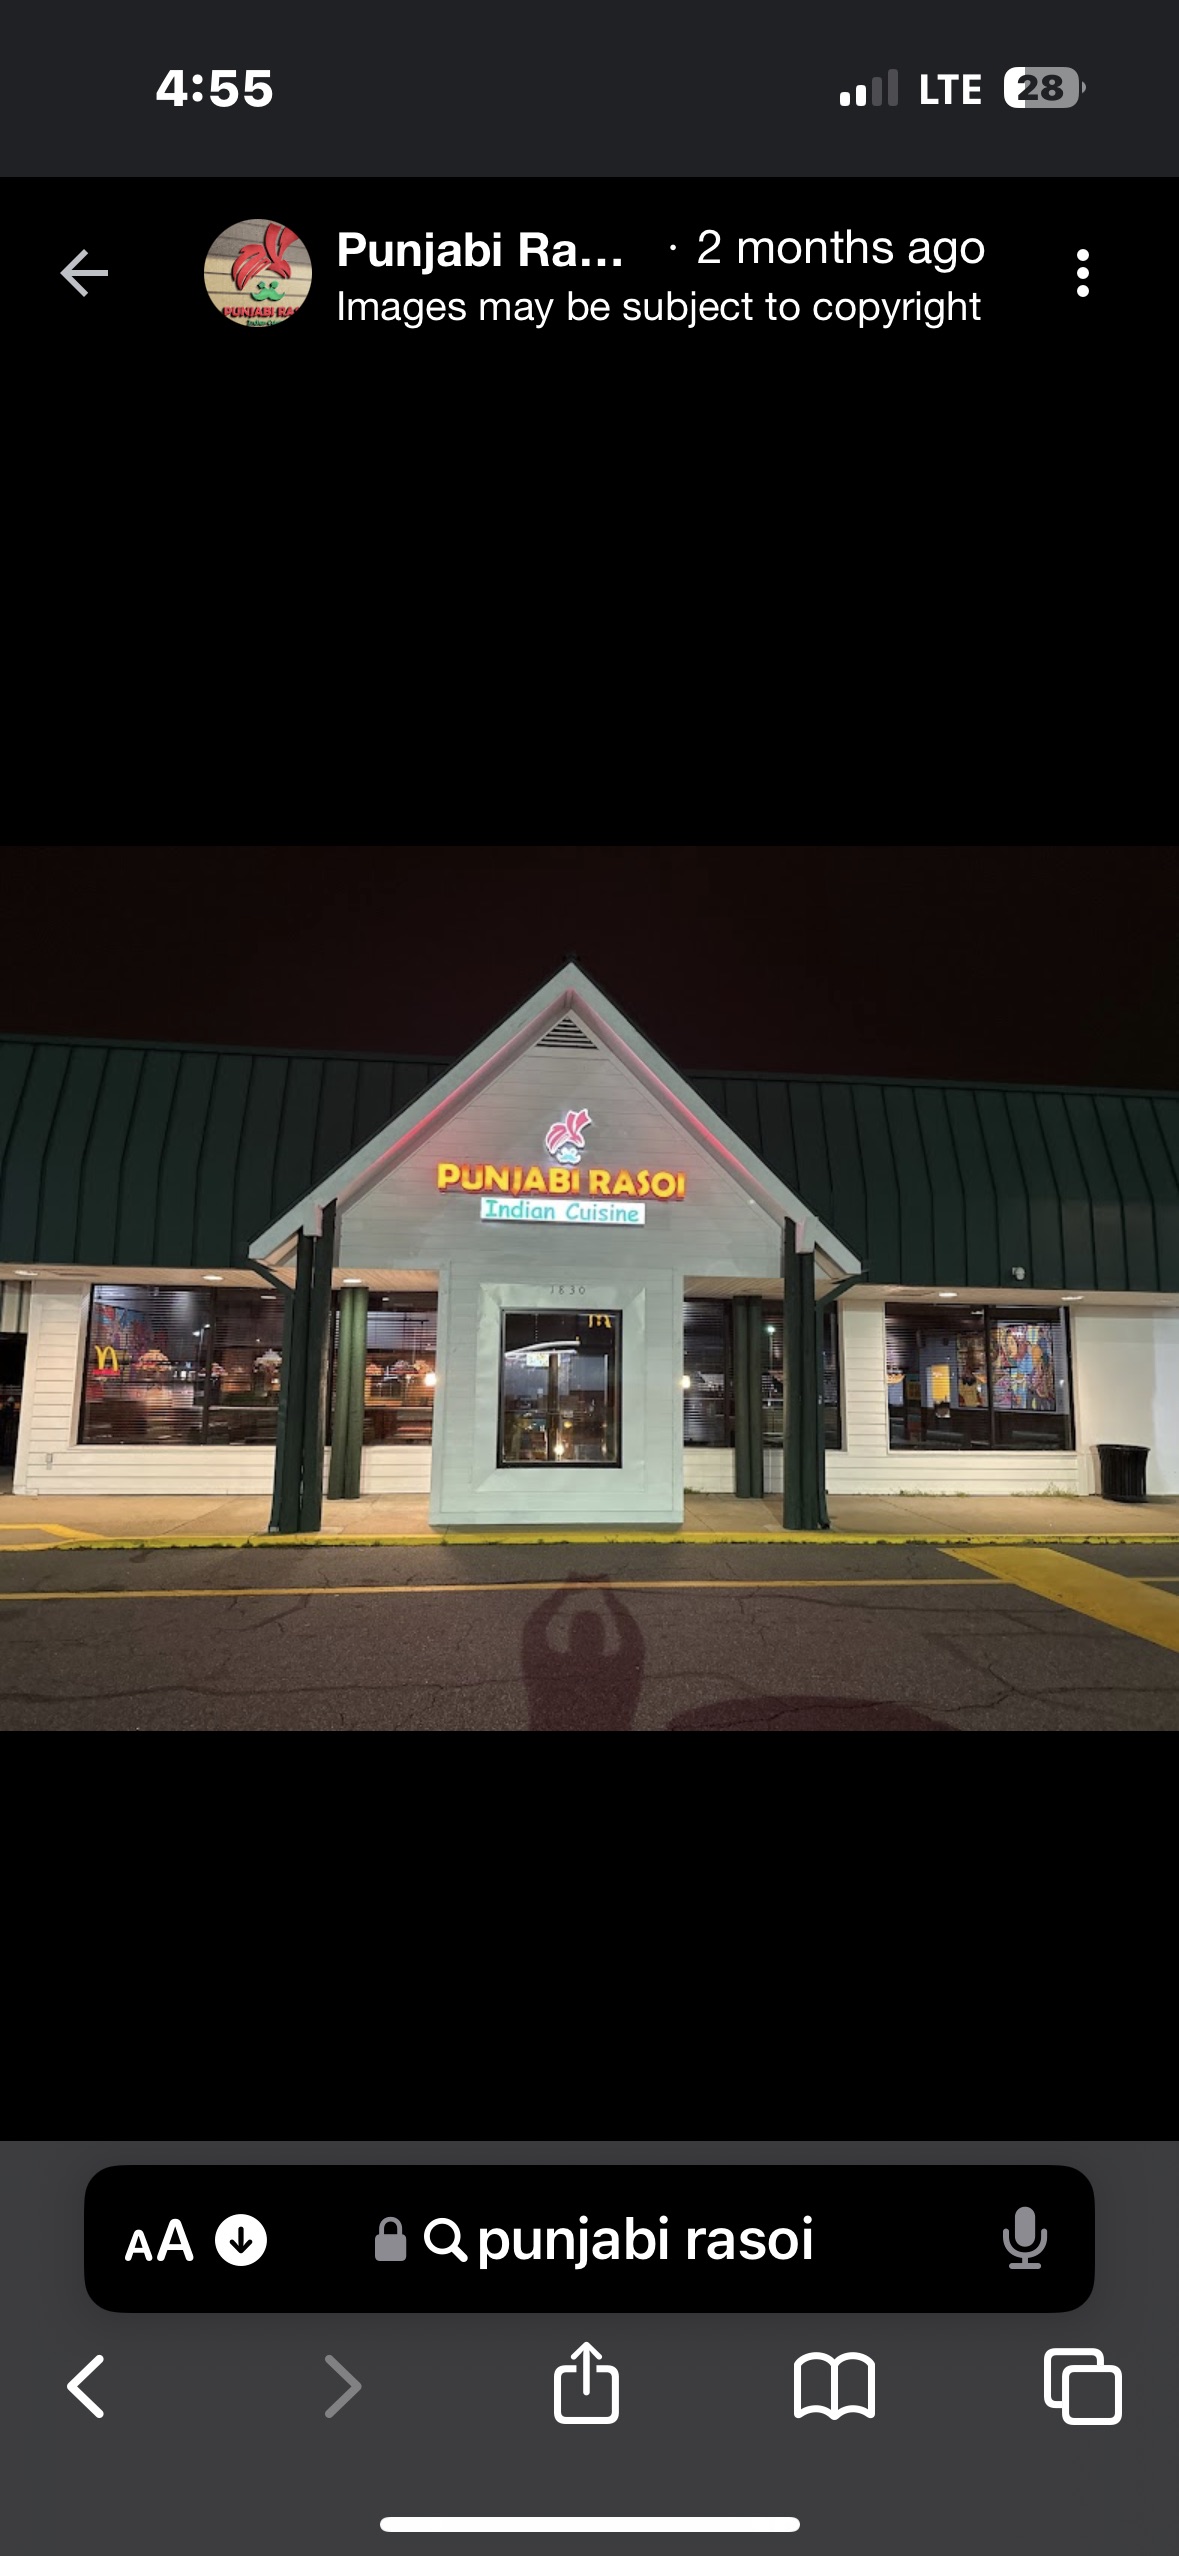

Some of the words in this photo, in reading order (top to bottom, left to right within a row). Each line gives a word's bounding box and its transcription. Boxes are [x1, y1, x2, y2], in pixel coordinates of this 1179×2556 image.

[437, 1163, 580, 1196] PUNJABI
[588, 1168, 686, 1201] RASOI
[485, 1199, 555, 1220] Indian
[566, 1203, 639, 1222] Cuisine
[550, 1285, 586, 1295] 1830
